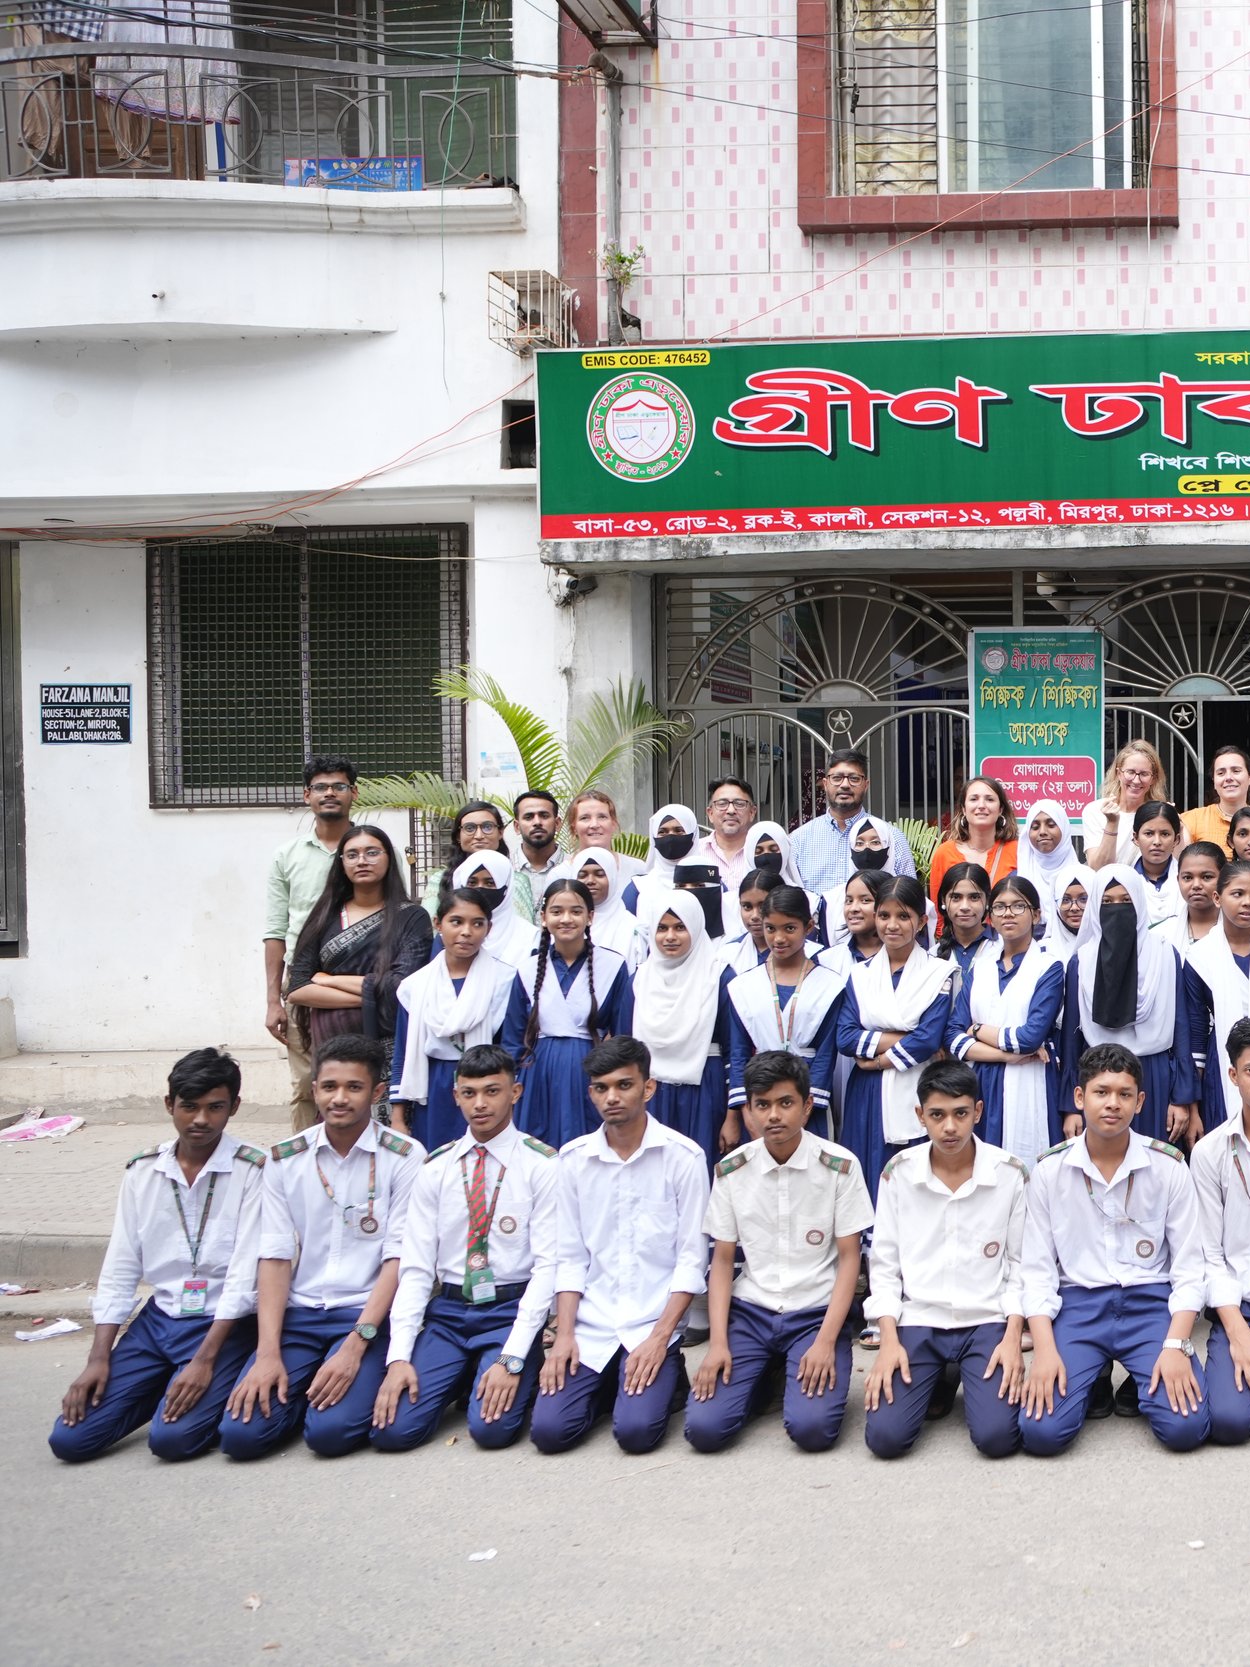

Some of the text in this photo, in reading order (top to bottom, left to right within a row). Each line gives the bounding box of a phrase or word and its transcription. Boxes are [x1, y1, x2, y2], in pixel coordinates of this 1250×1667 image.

[585, 353, 707, 366] EMIS CODE: 476452
[713, 367, 1007, 456] গ্রীণ
[1138, 452, 1209, 470] শিখবে
[1183, 479, 1222, 493] প্লে
[573, 517, 658, 535] বাসা-৫৩,
[666, 515, 736, 532] রোড-২,
[743, 510, 802, 530] ব্লক-ই,
[809, 507, 873, 529] কালশী,
[881, 507, 991, 526] সেকশন-১২,
[998, 502, 1053, 523] পল্লবী,
[1059, 501, 1124, 521] মিরপুর,
[1130, 502, 1234, 519] ঢাকা-১২১৬
[1030, 652, 1051, 670] ঢাকা
[42, 687, 130, 703] FARZANA MANJIL
[980, 678, 1026, 709] শিক্ষক
[1042, 678, 1098, 709] শিক্ষিকা
[1008, 722, 1069, 746] আবশ্যক
[1017, 781, 1039, 793] কক্ষ
